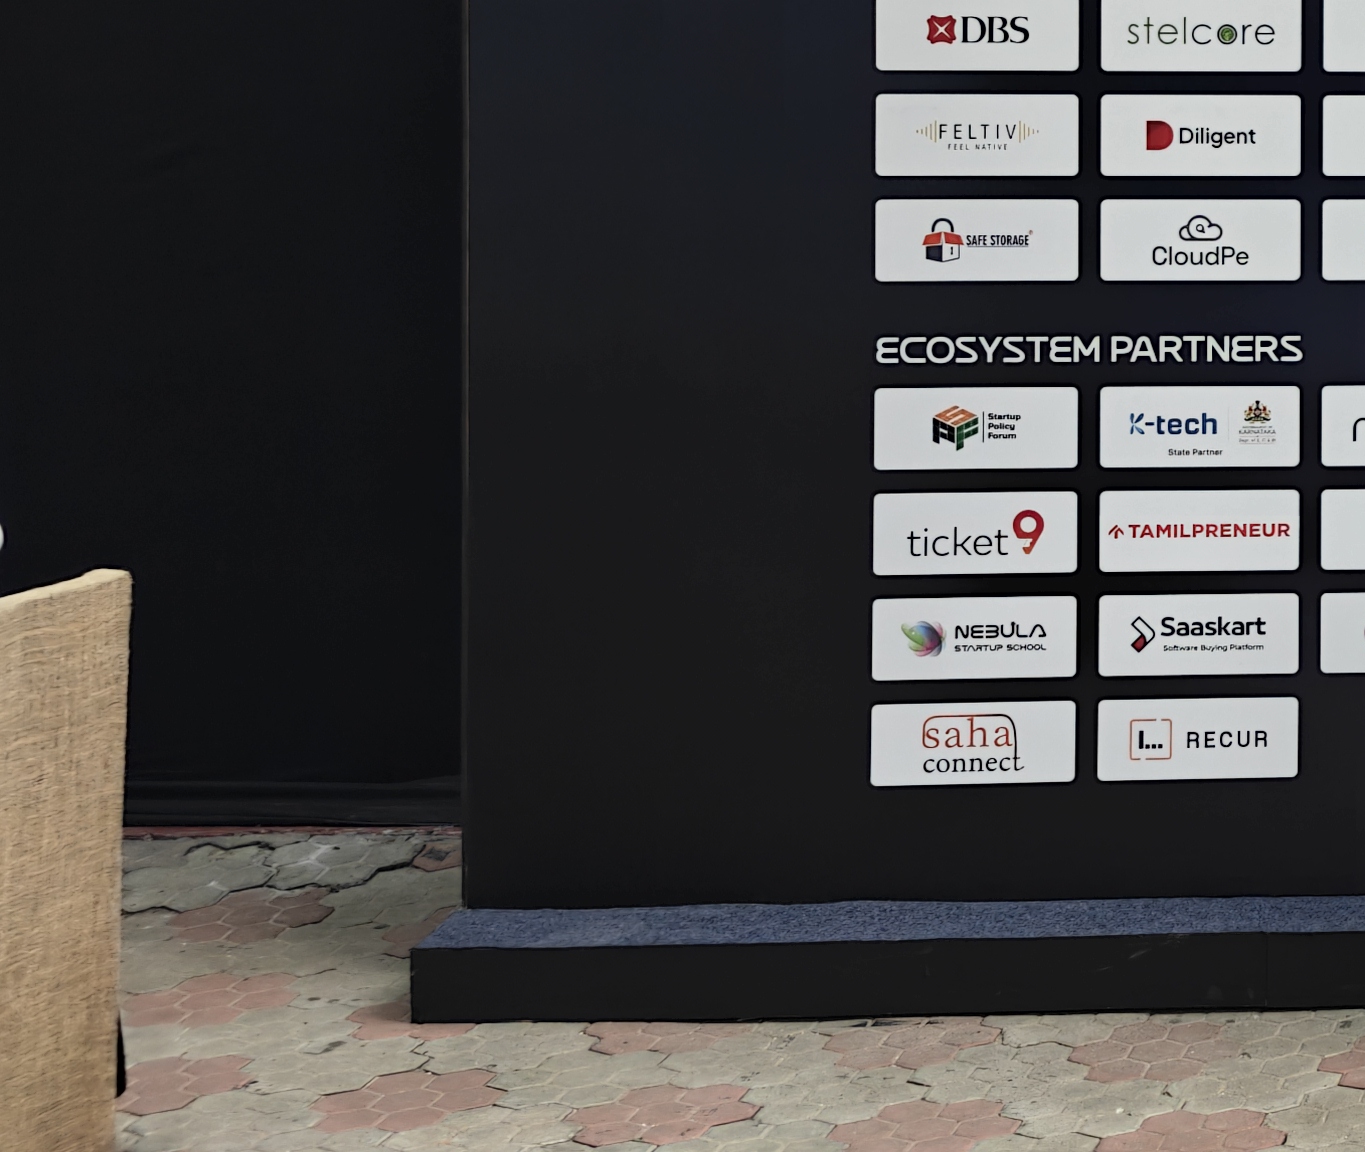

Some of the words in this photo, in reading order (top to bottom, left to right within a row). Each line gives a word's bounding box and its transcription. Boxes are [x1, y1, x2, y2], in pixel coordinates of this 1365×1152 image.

[962, 16, 1030, 44] DBS
[1127, 16, 1276, 46] stelcore
[938, 123, 1018, 140] FELTIV
[1179, 128, 1256, 148] Diligent
[966, 234, 988, 246] SAFE
[990, 233, 1029, 246] STORAGE
[1152, 246, 1250, 266] CloudPe
[876, 336, 1100, 364] ECOSYSTEM
[1110, 335, 1304, 363] PARTNERS
[988, 412, 1022, 422] Startup
[1130, 412, 1218, 436] K-tech
[988, 422, 1016, 432] Policy
[988, 432, 1017, 440] Forum
[1168, 448, 1190, 456] State
[1192, 448, 1223, 456] Partner
[1128, 523, 1290, 538] TAMILPRENEUR
[954, 622, 1047, 639] NEBULA
[1160, 616, 1266, 636] Saaskart
[954, 644, 1004, 652] STARTUP
[1006, 643, 1046, 652] SCHOOL
[923, 718, 1014, 749] saha
[1186, 731, 1268, 749] RECUR
[923, 755, 1025, 774] connect
